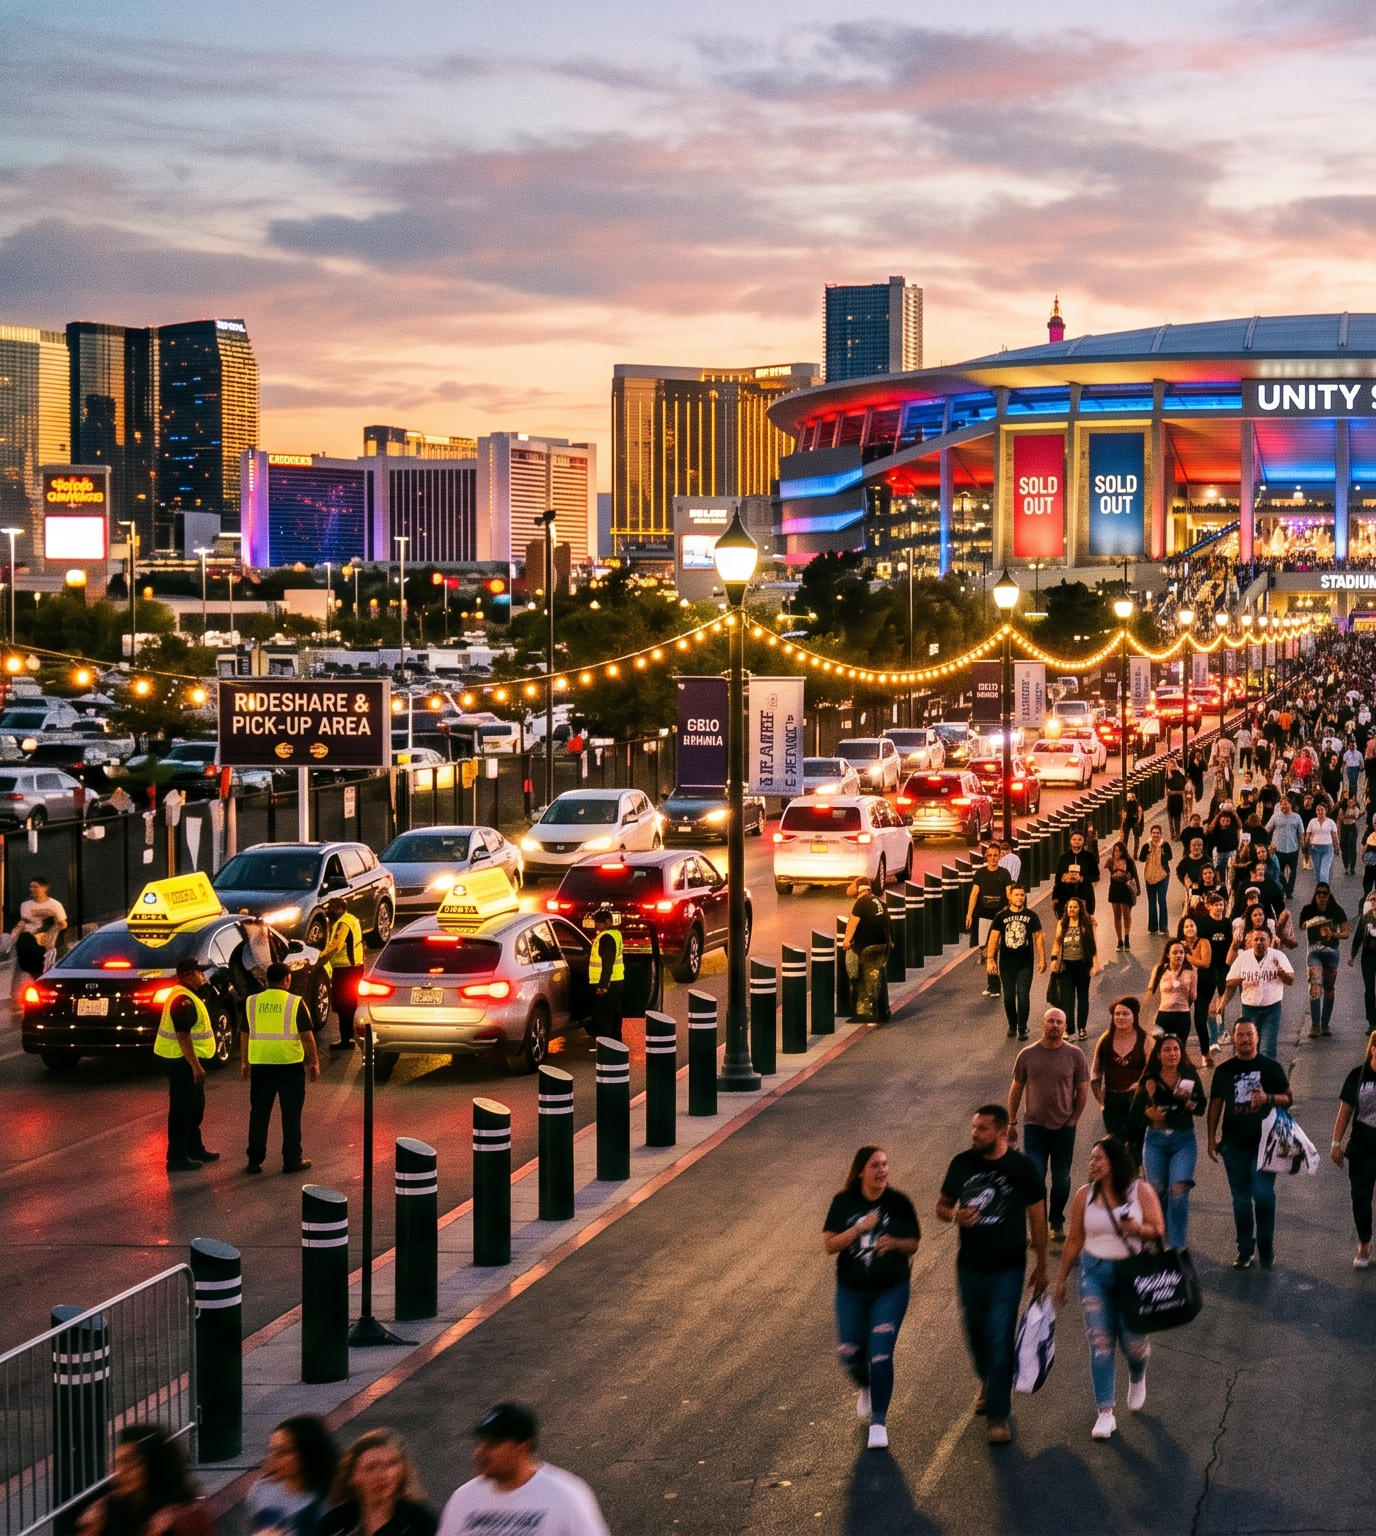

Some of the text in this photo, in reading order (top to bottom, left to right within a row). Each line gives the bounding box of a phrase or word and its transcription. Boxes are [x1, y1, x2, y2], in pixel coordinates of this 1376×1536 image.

[1258, 384, 1361, 410] UNITY
[1019, 476, 1058, 495] SOLD
[1094, 475, 1138, 494] SOLD
[1023, 497, 1054, 515] OUT
[1100, 495, 1134, 514] OUT
[234, 692, 370, 713] RIDESHARE &
[232, 715, 372, 736] PICK-UP AREA
